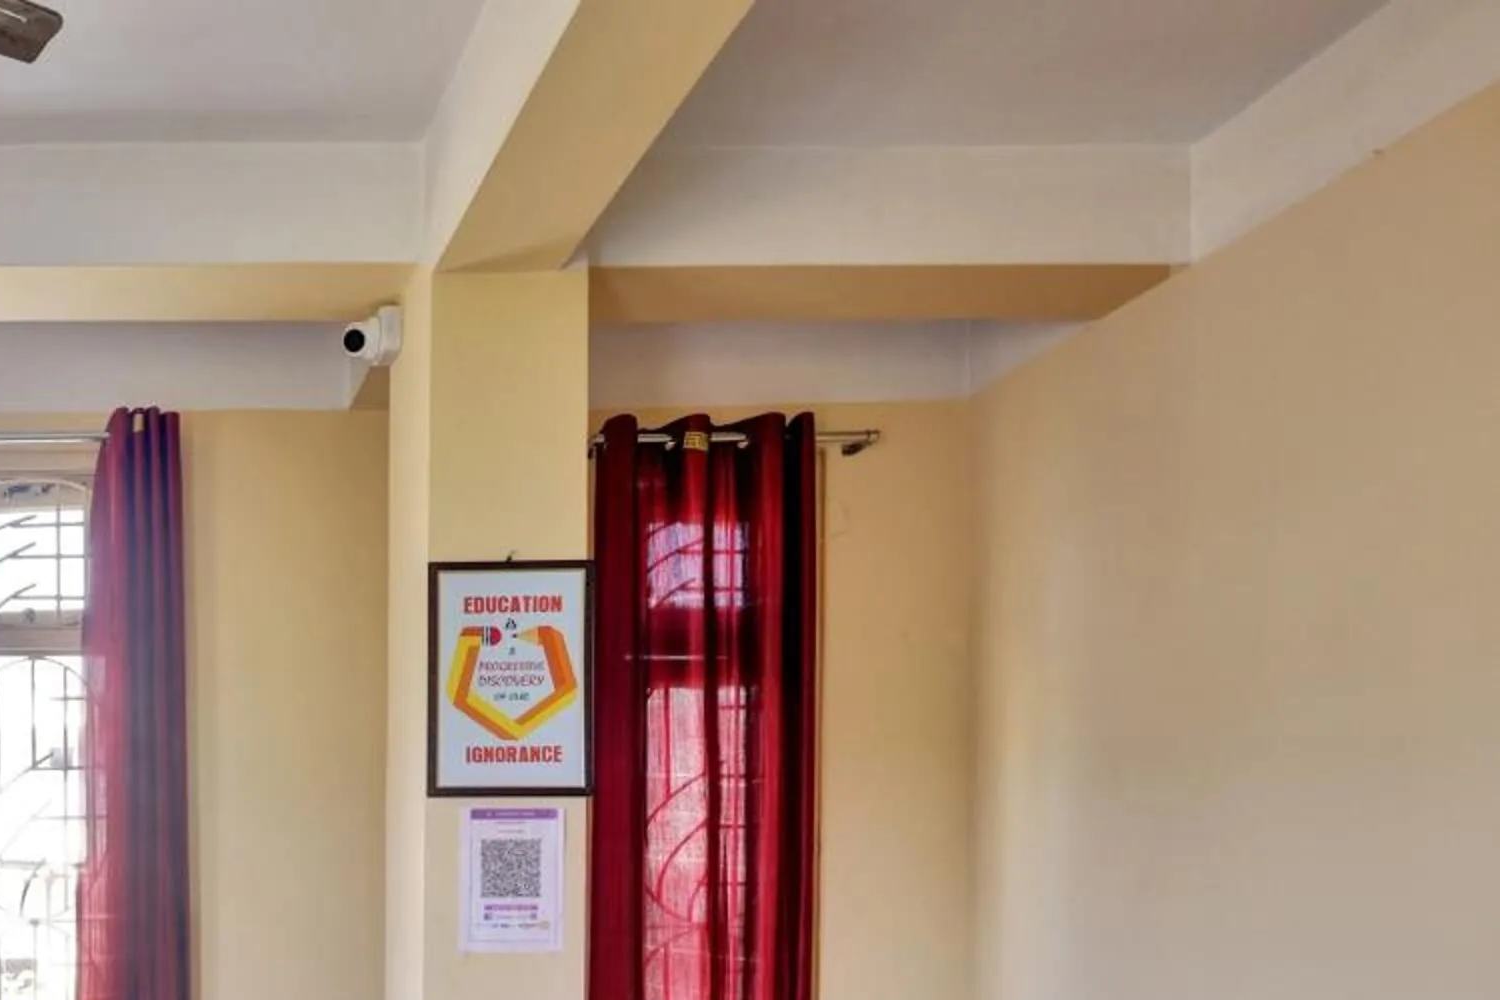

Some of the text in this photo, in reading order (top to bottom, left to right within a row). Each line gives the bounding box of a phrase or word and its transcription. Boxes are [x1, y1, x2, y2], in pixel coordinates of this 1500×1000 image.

[463, 596, 563, 614] EDUCATION
[478, 675, 545, 687] DISCOVERY
[465, 746, 563, 763] IGNORANCE
